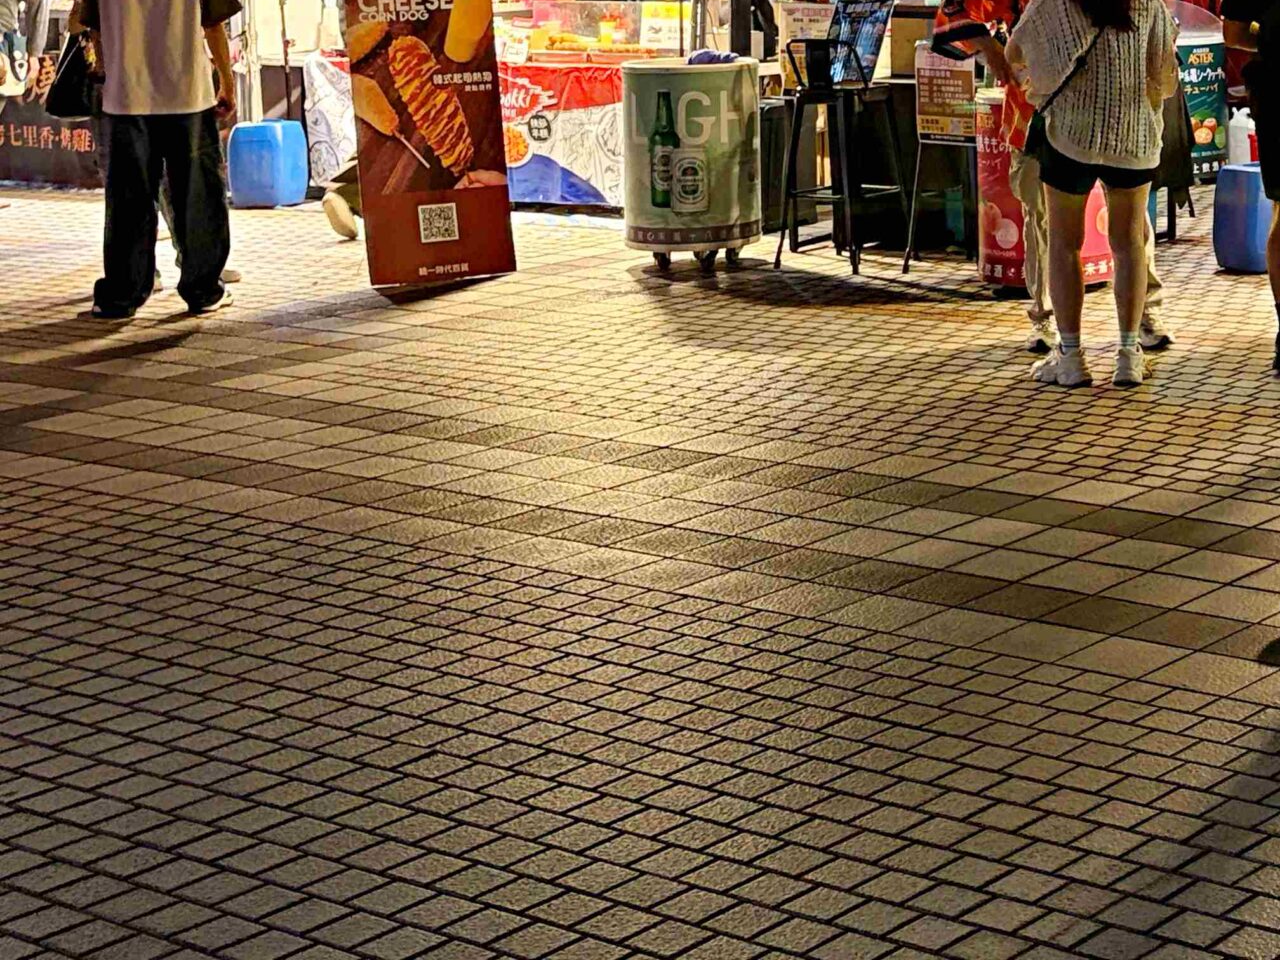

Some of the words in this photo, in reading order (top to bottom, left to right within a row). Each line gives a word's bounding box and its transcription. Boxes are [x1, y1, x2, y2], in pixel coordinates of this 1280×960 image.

[359, 10, 396, 23] CORN
[400, 9, 429, 21] DOG
[1188, 53, 1213, 64] ASTER
